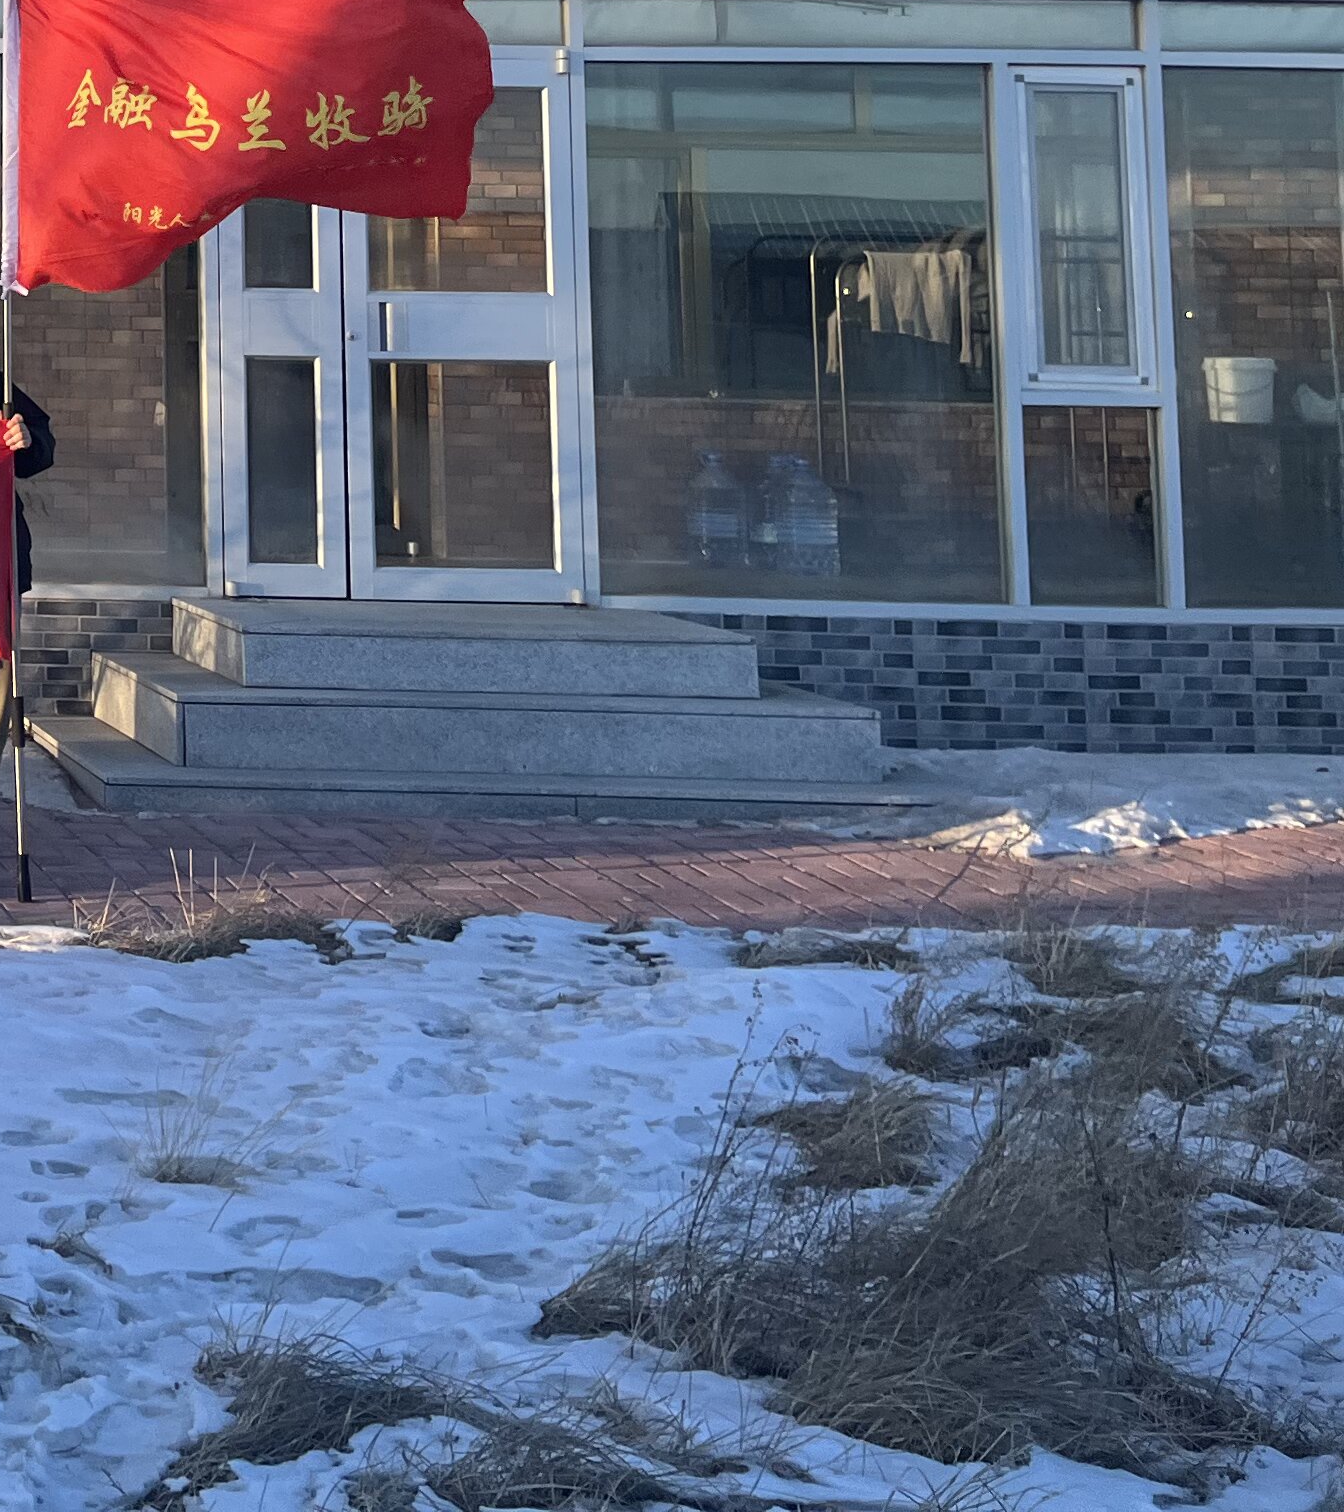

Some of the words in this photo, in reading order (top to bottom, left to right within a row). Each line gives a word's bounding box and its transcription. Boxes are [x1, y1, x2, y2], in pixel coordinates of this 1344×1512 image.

[66, 69, 434, 151] 金融乌兰牧骑
[123, 202, 213, 230] 阳光人
